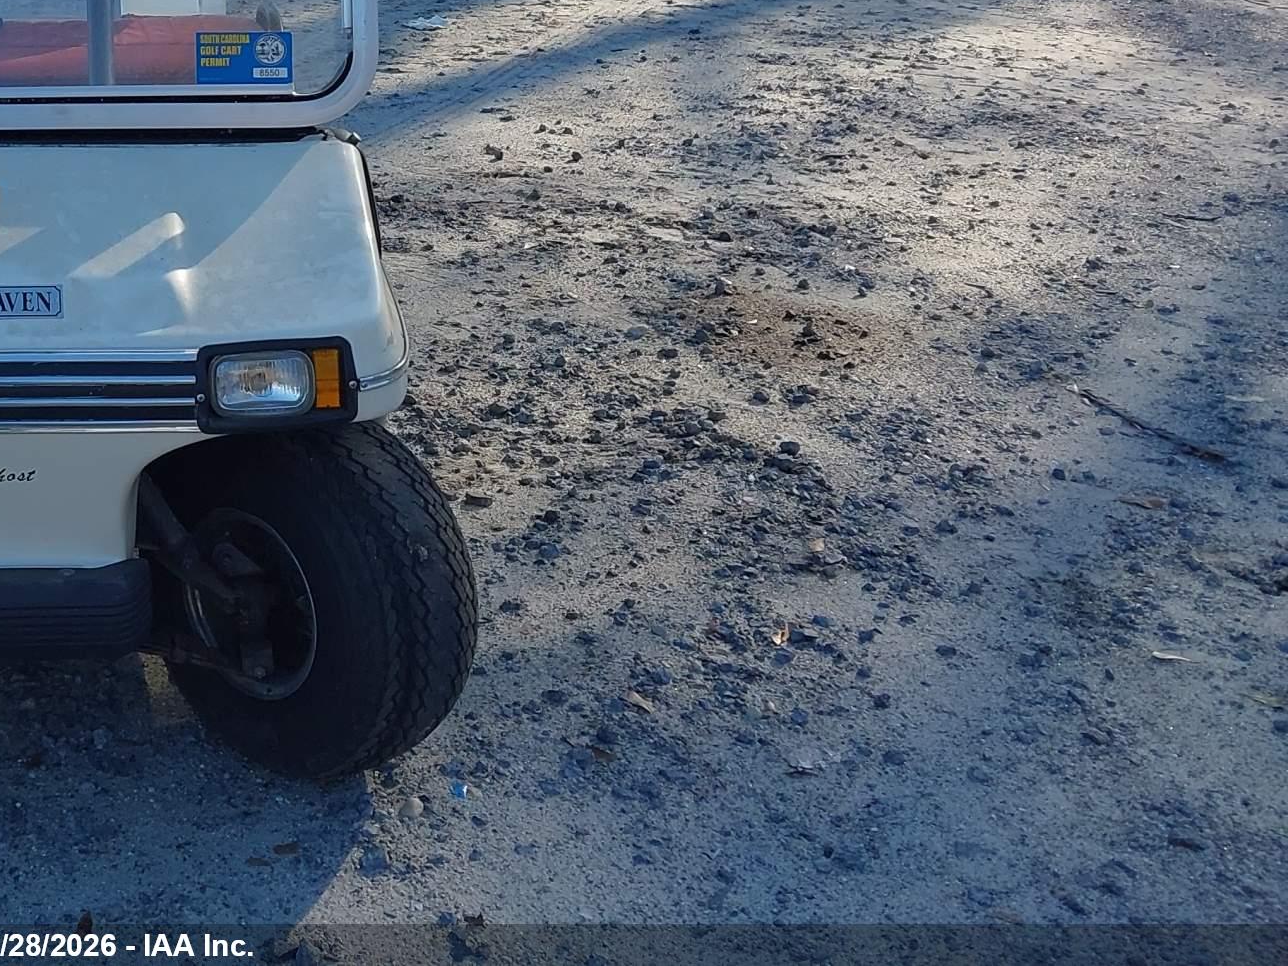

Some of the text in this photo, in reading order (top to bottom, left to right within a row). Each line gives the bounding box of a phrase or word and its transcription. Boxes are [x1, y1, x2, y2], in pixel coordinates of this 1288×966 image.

[200, 45, 242, 55] GOLF CART
[200, 57, 231, 67] PERMIT
